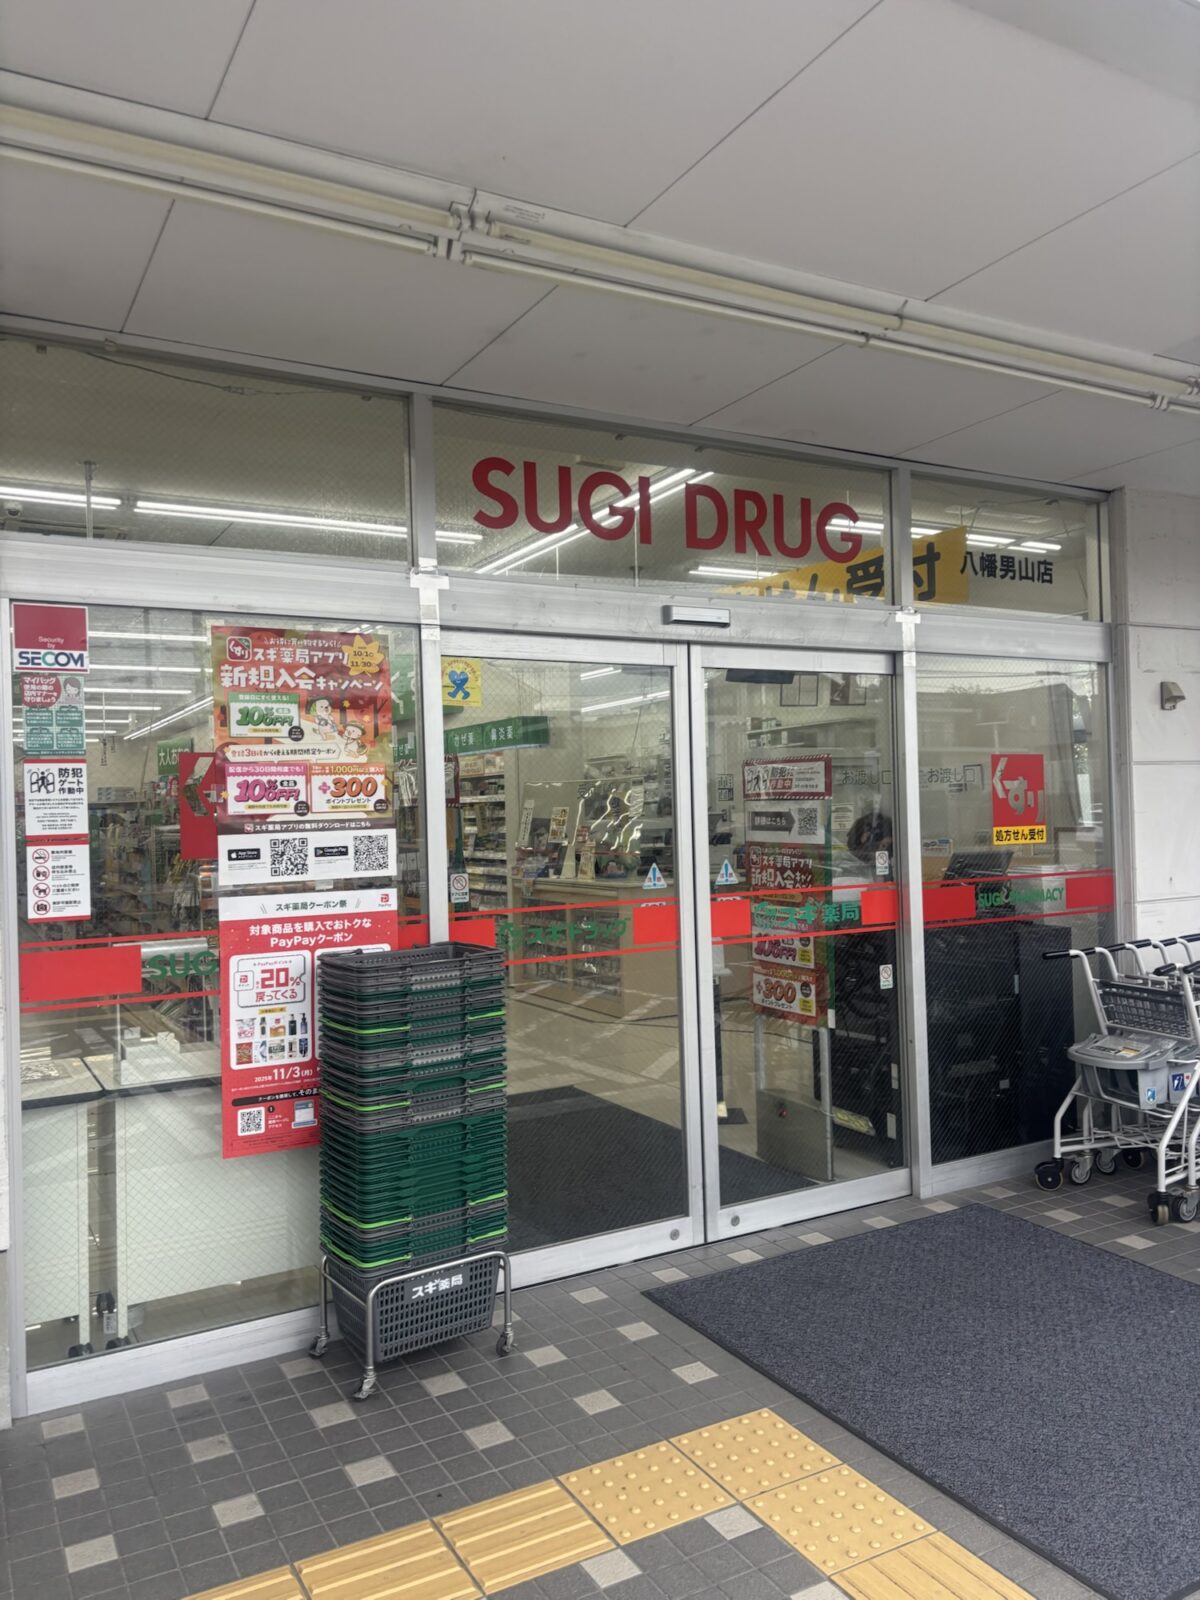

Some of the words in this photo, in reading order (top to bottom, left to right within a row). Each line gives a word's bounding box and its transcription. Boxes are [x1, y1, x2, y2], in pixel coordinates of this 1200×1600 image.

[472, 456, 651, 545] SUGI
[685, 482, 863, 564] DRUG
[960, 550, 1053, 585] 八幡男山店
[38, 636, 64, 645] Security
[18, 651, 84, 668] SECOM
[253, 648, 349, 664] スギ薬局アプリ
[58, 767, 83, 778] 防犯
[58, 779, 83, 787] ゲート
[58, 787, 84, 795] 作動中
[234, 779, 278, 803] 10%
[993, 757, 1045, 823] くすり
[995, 828, 1045, 842] 処方せん受付
[276, 900, 348, 912] スギ薬局クーポン祭
[775, 900, 860, 928] スギ薬局
[249, 918, 372, 936] 対象商品を購入でおトクな
[270, 932, 353, 948] PayPayクーポン
[149, 950, 218, 981] SUG
[261, 967, 301, 989] 20%
[255, 988, 298, 1003] 戻ってくる
[273, 1066, 300, 1081] 11/3
[411, 1274, 463, 1299] スギ薬局
